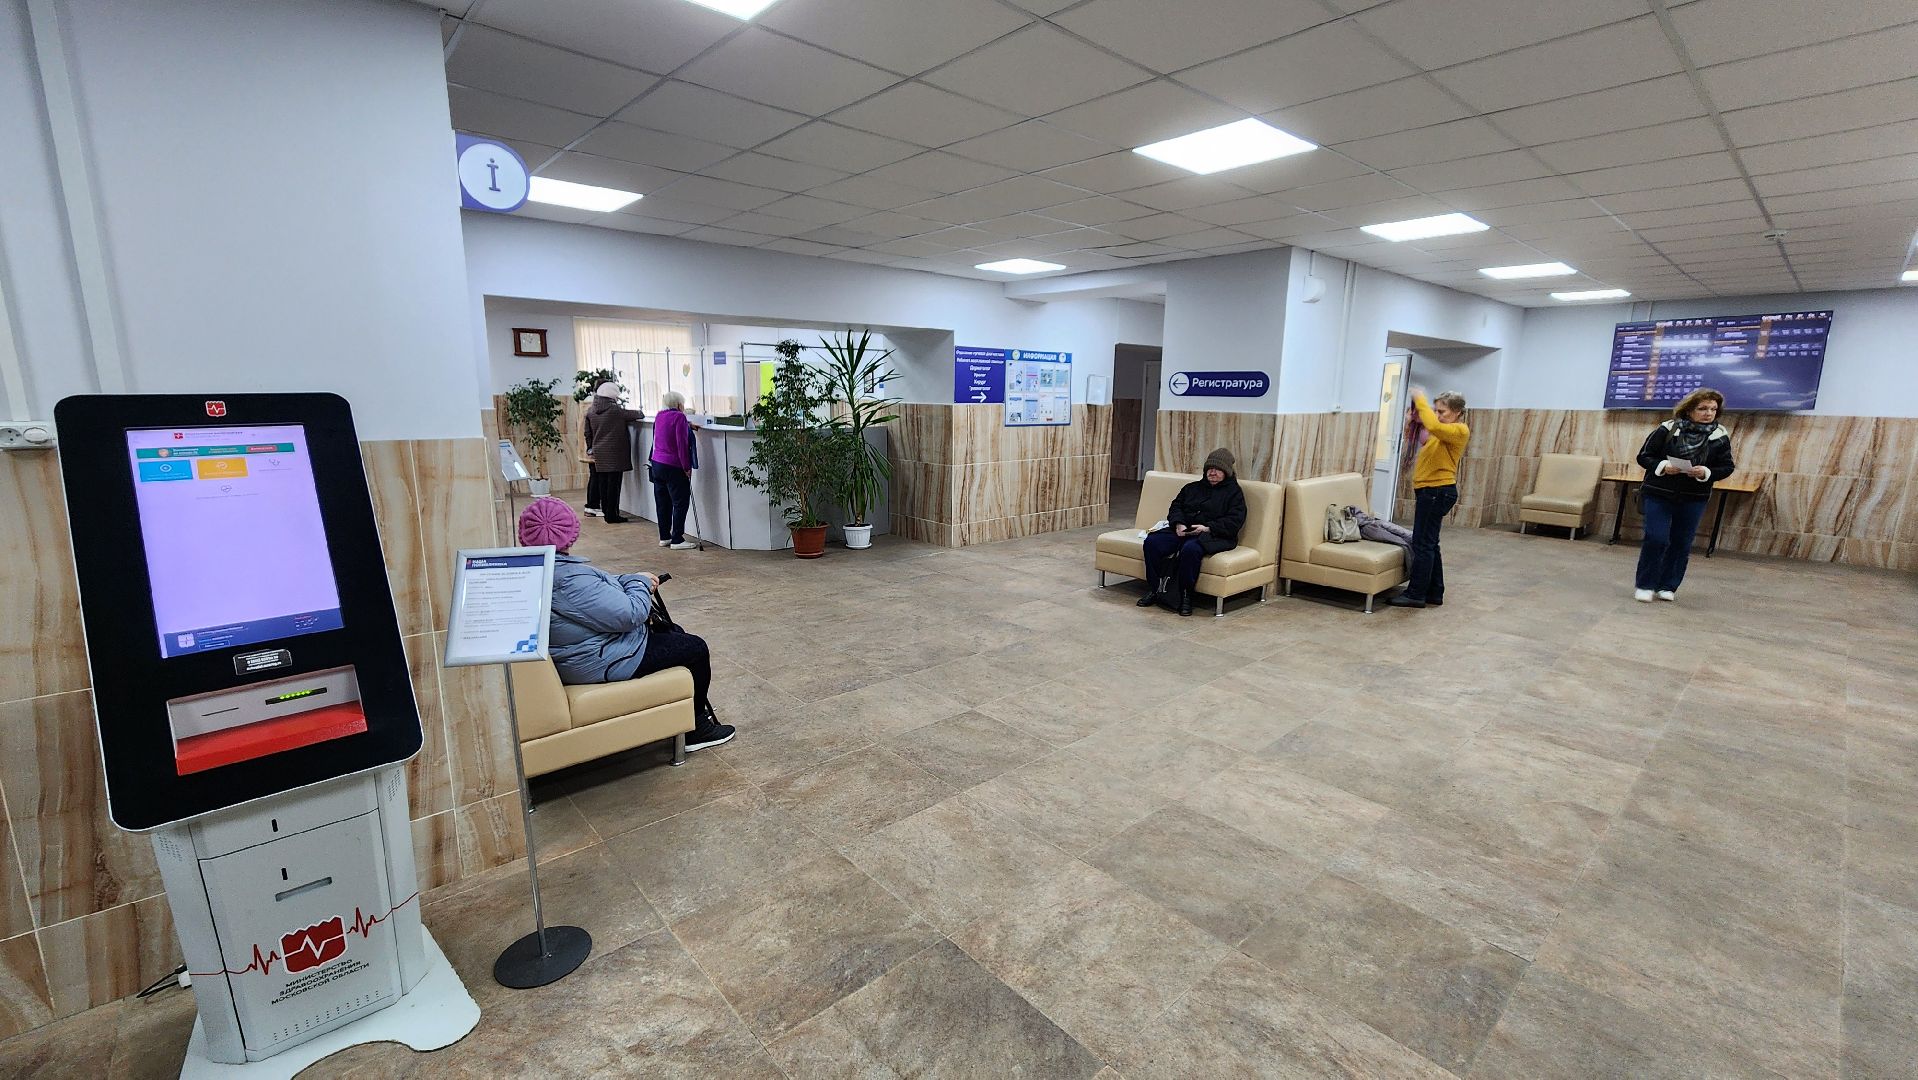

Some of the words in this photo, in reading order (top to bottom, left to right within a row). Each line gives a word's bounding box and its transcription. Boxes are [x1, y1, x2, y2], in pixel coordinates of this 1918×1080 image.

[1023, 352, 1057, 360] ИНФОРМАЦИЯ
[1192, 378, 1263, 389] Регистратура
[271, 978, 331, 1005] МОСКОВСКОЙ
[331, 962, 370, 982] ОБЛАСТИ
[279, 960, 362, 996] ЗДРАВООХРАНЕНИЯ
[285, 959, 353, 988] МИНИСТЕРСТВО
